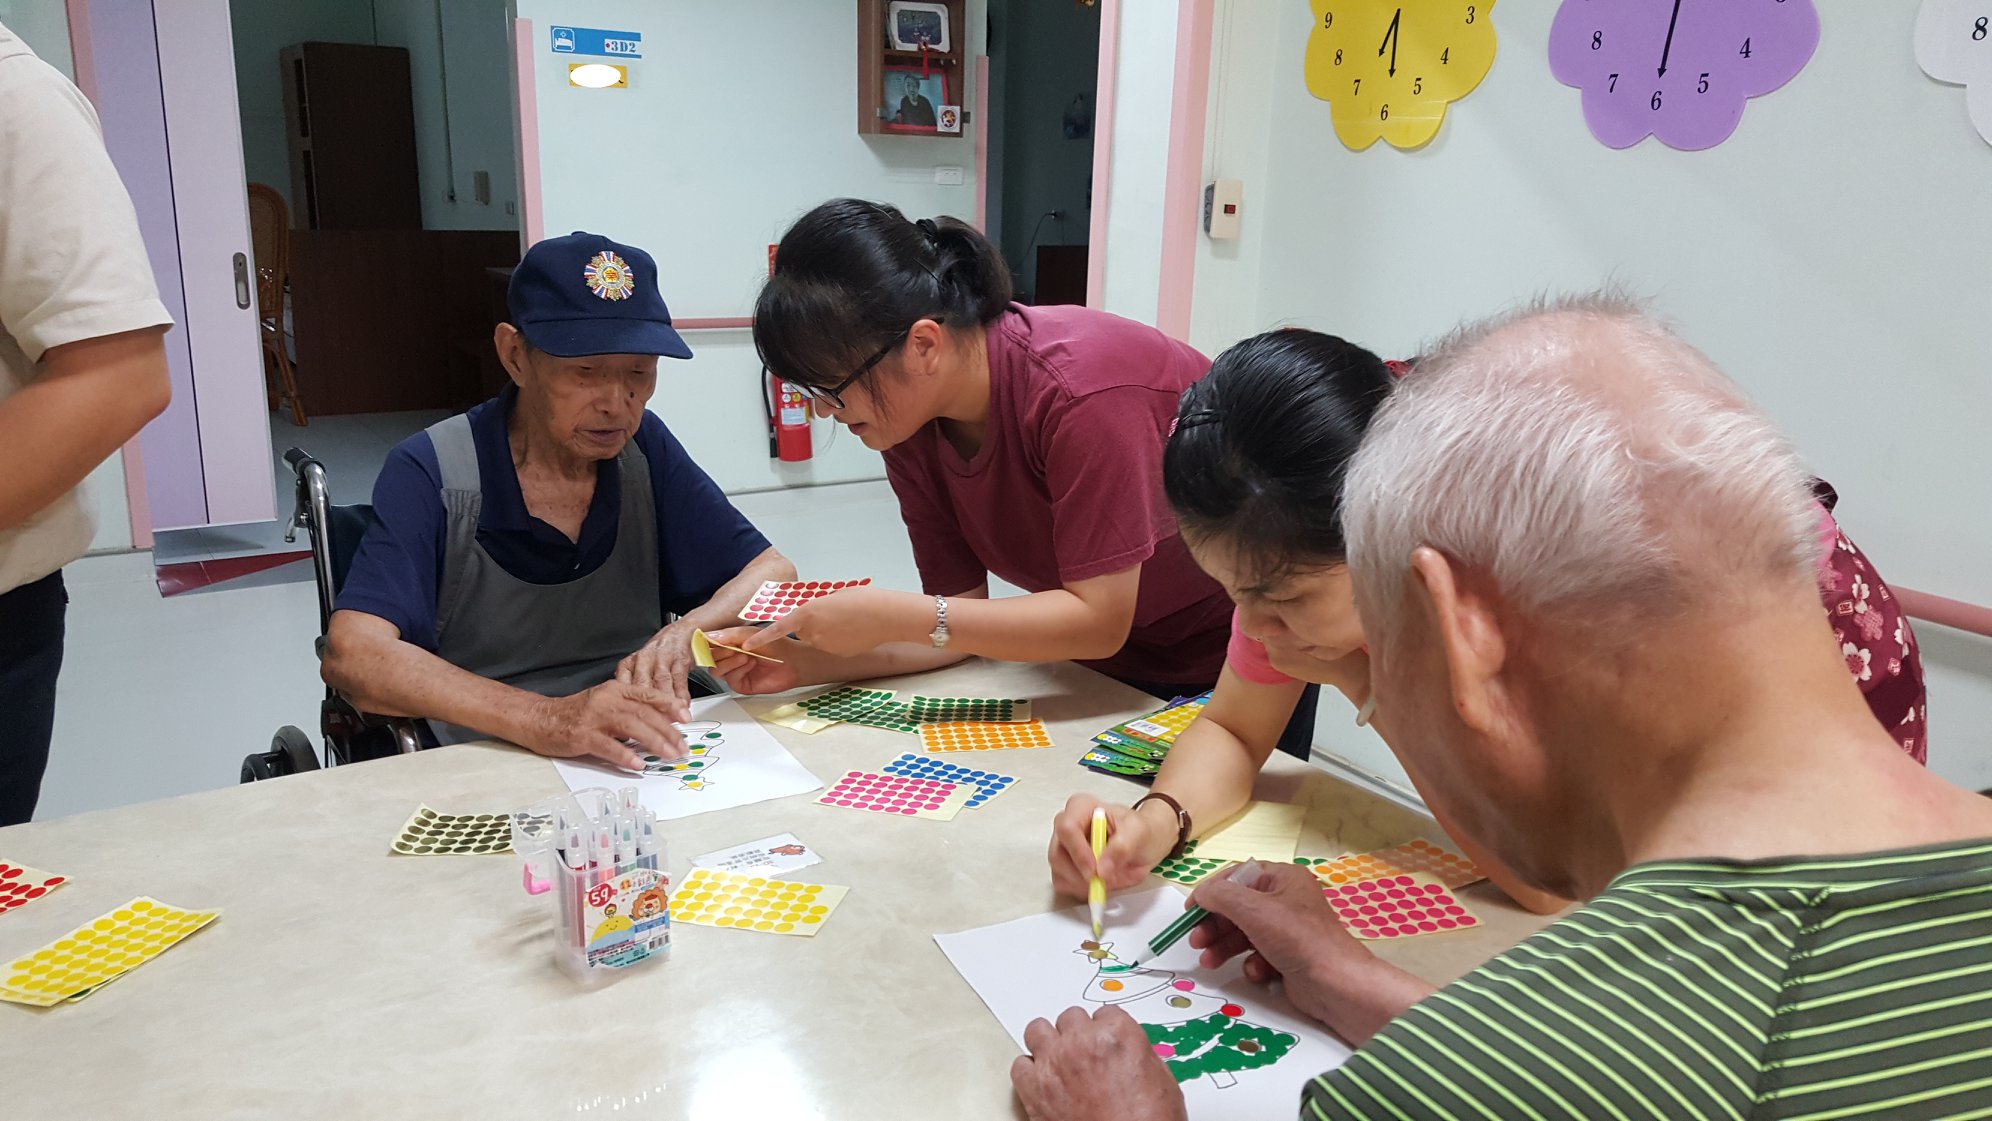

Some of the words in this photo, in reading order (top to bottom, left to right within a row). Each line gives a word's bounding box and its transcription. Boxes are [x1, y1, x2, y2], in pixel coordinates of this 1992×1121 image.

[1324, 11, 1333, 29] 9
[1465, 5, 1476, 25] 3
[1971, 16, 1989, 41] 8
[611, 41, 636, 53] 3D2
[1591, 30, 1603, 50] 8
[1739, 37, 1752, 59] 4
[1334, 48, 1343, 66] 8
[1440, 47, 1449, 65] 4
[1353, 78, 1362, 96] 7
[1413, 77, 1422, 95] 5
[1608, 73, 1619, 94] 7
[1697, 72, 1710, 94] 5
[1650, 90, 1662, 111] 6
[1380, 103, 1389, 121] 6
[591, 887, 609, 905] 59
